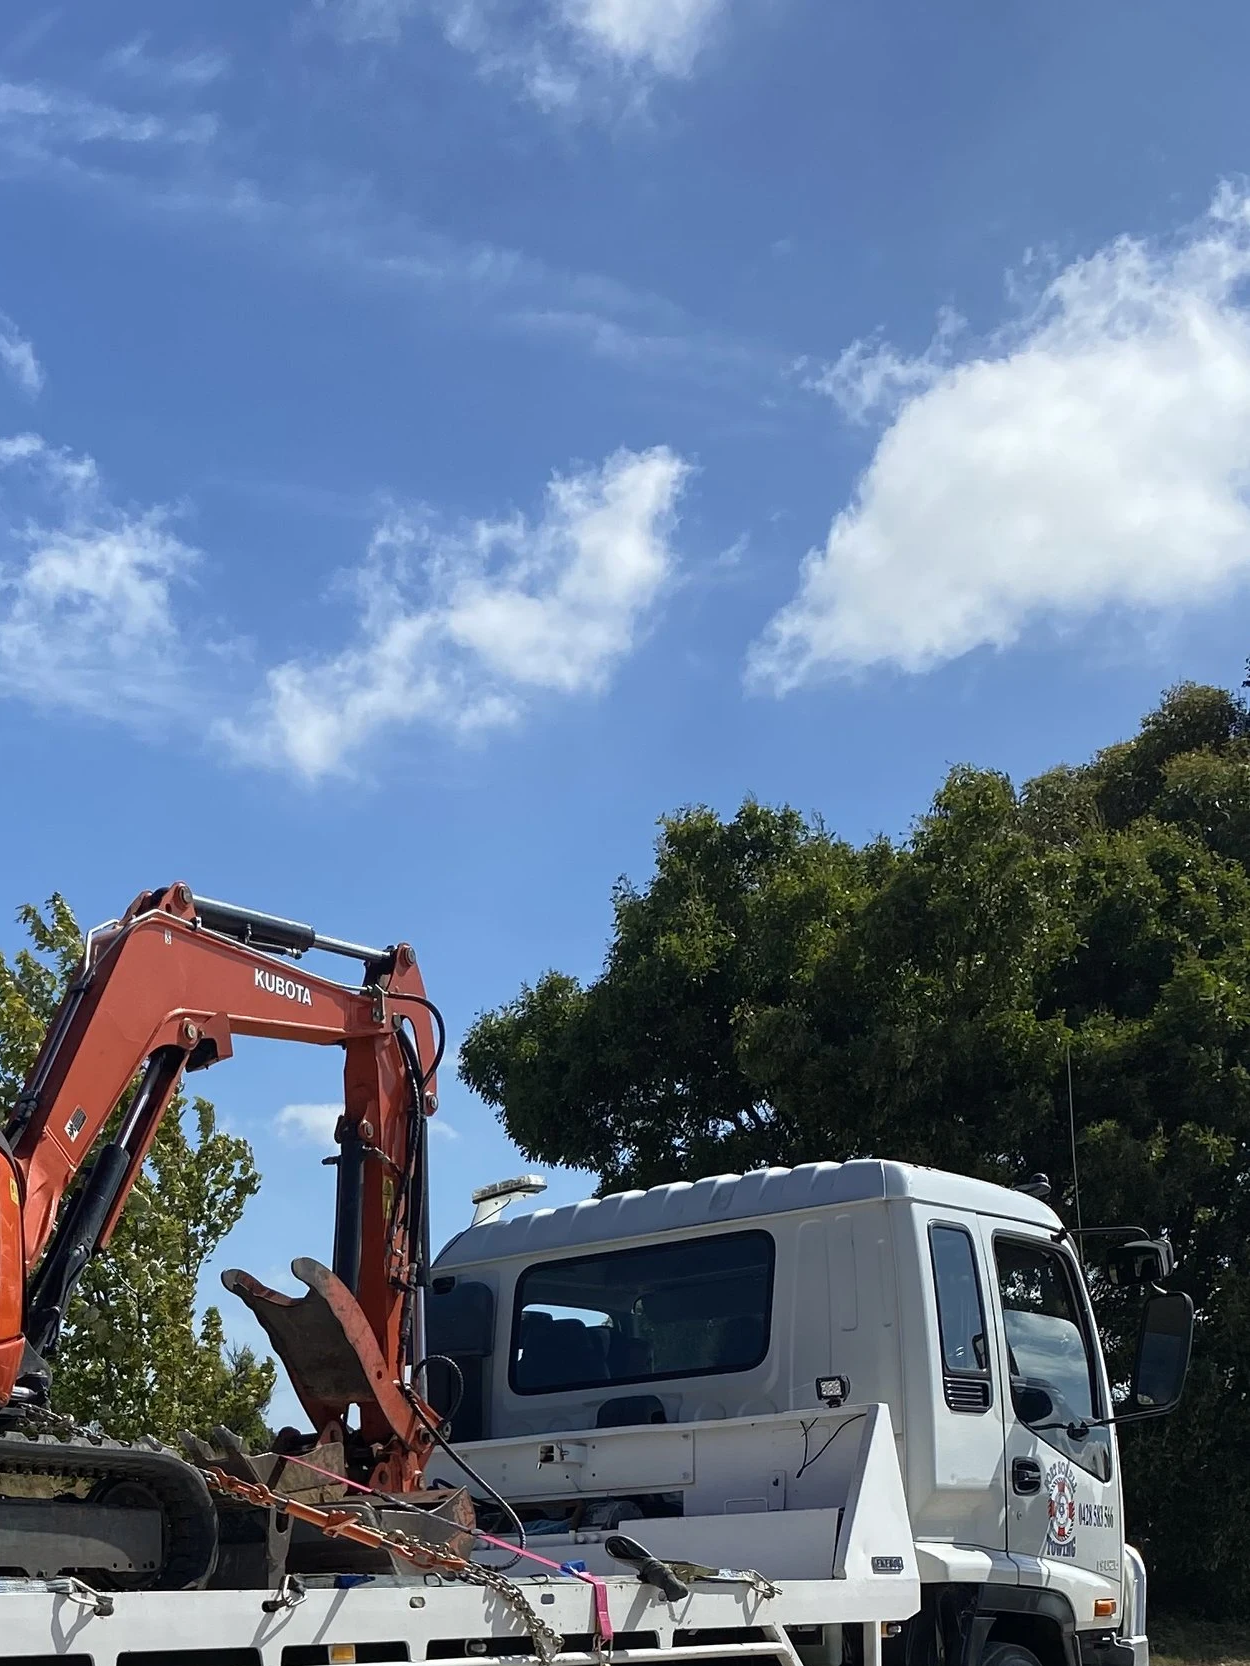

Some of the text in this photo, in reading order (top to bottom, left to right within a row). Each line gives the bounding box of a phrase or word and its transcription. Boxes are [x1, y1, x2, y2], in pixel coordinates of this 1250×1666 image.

[254, 967, 313, 1006] KUBOTA
[1078, 1502, 1093, 1527] 0428
[1046, 1532, 1076, 1558] TOWING
